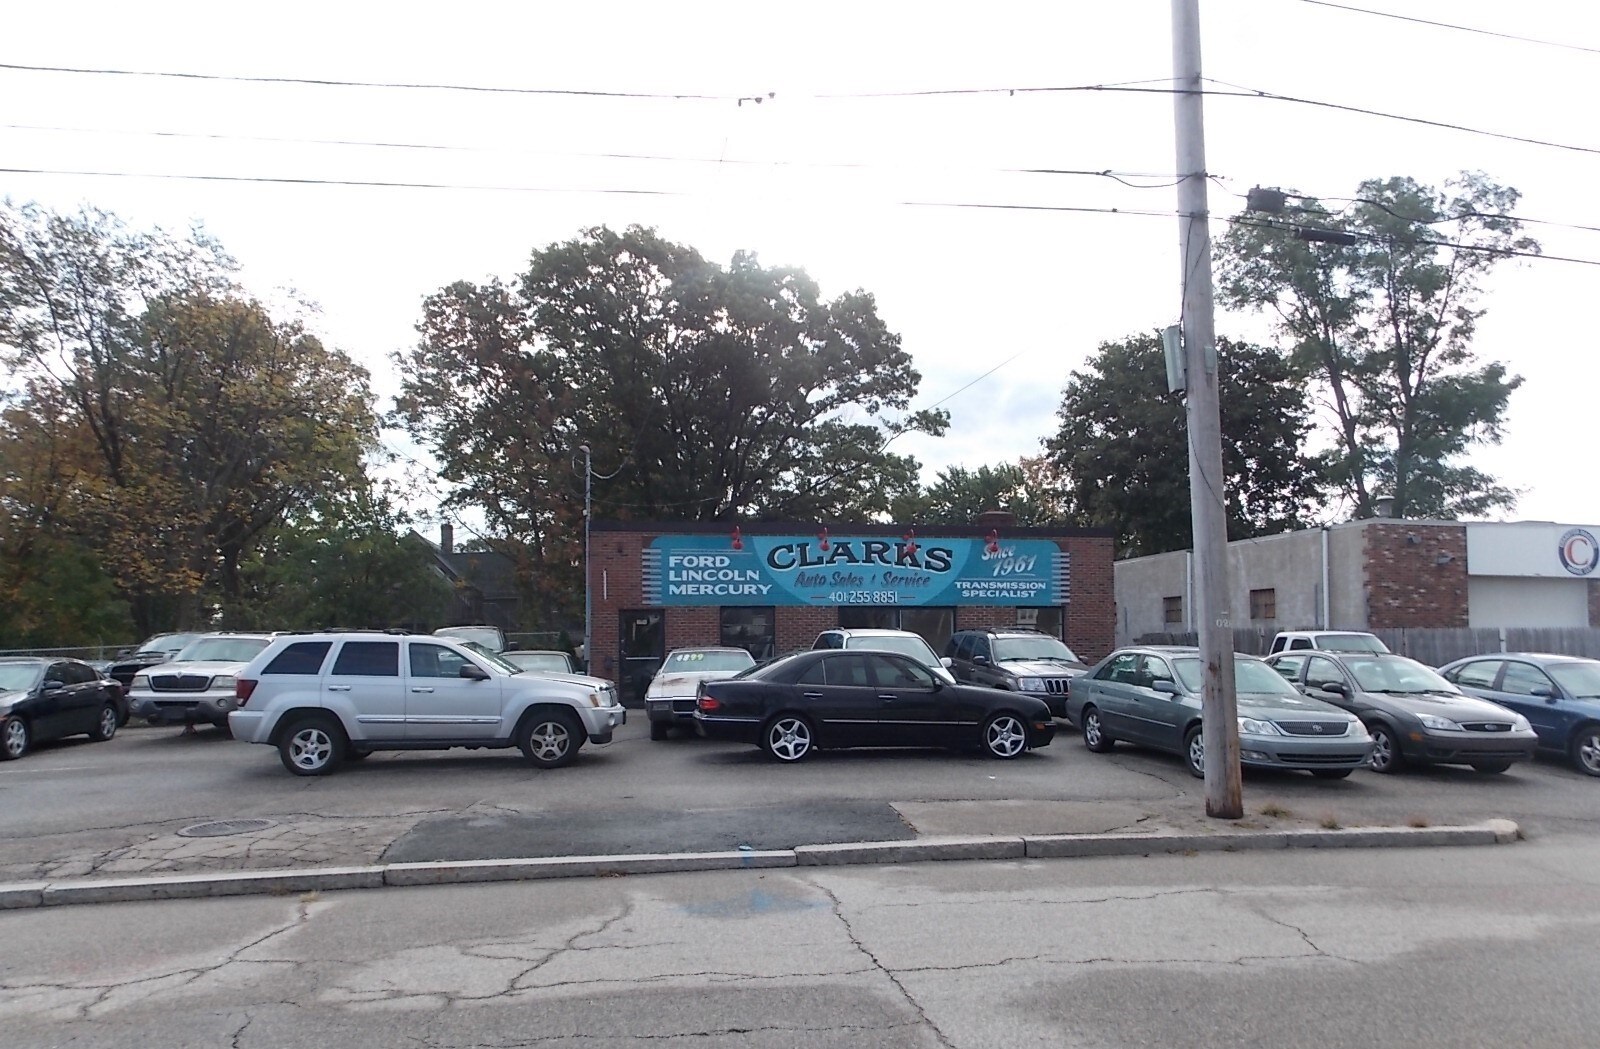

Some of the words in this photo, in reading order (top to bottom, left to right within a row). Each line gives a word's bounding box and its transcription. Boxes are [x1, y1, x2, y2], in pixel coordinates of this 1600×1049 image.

[668, 555, 731, 568] FORD
[767, 541, 953, 574] CLARKS
[992, 553, 1037, 577] 1961
[668, 569, 760, 582] LINCOLN
[794, 571, 826, 588] Auto
[829, 571, 864, 587] Sales
[881, 571, 931, 588] Service
[668, 583, 773, 596] MERCURY
[954, 581, 1047, 590] TRANSMISSION
[961, 590, 1037, 598] SPECIALIST
